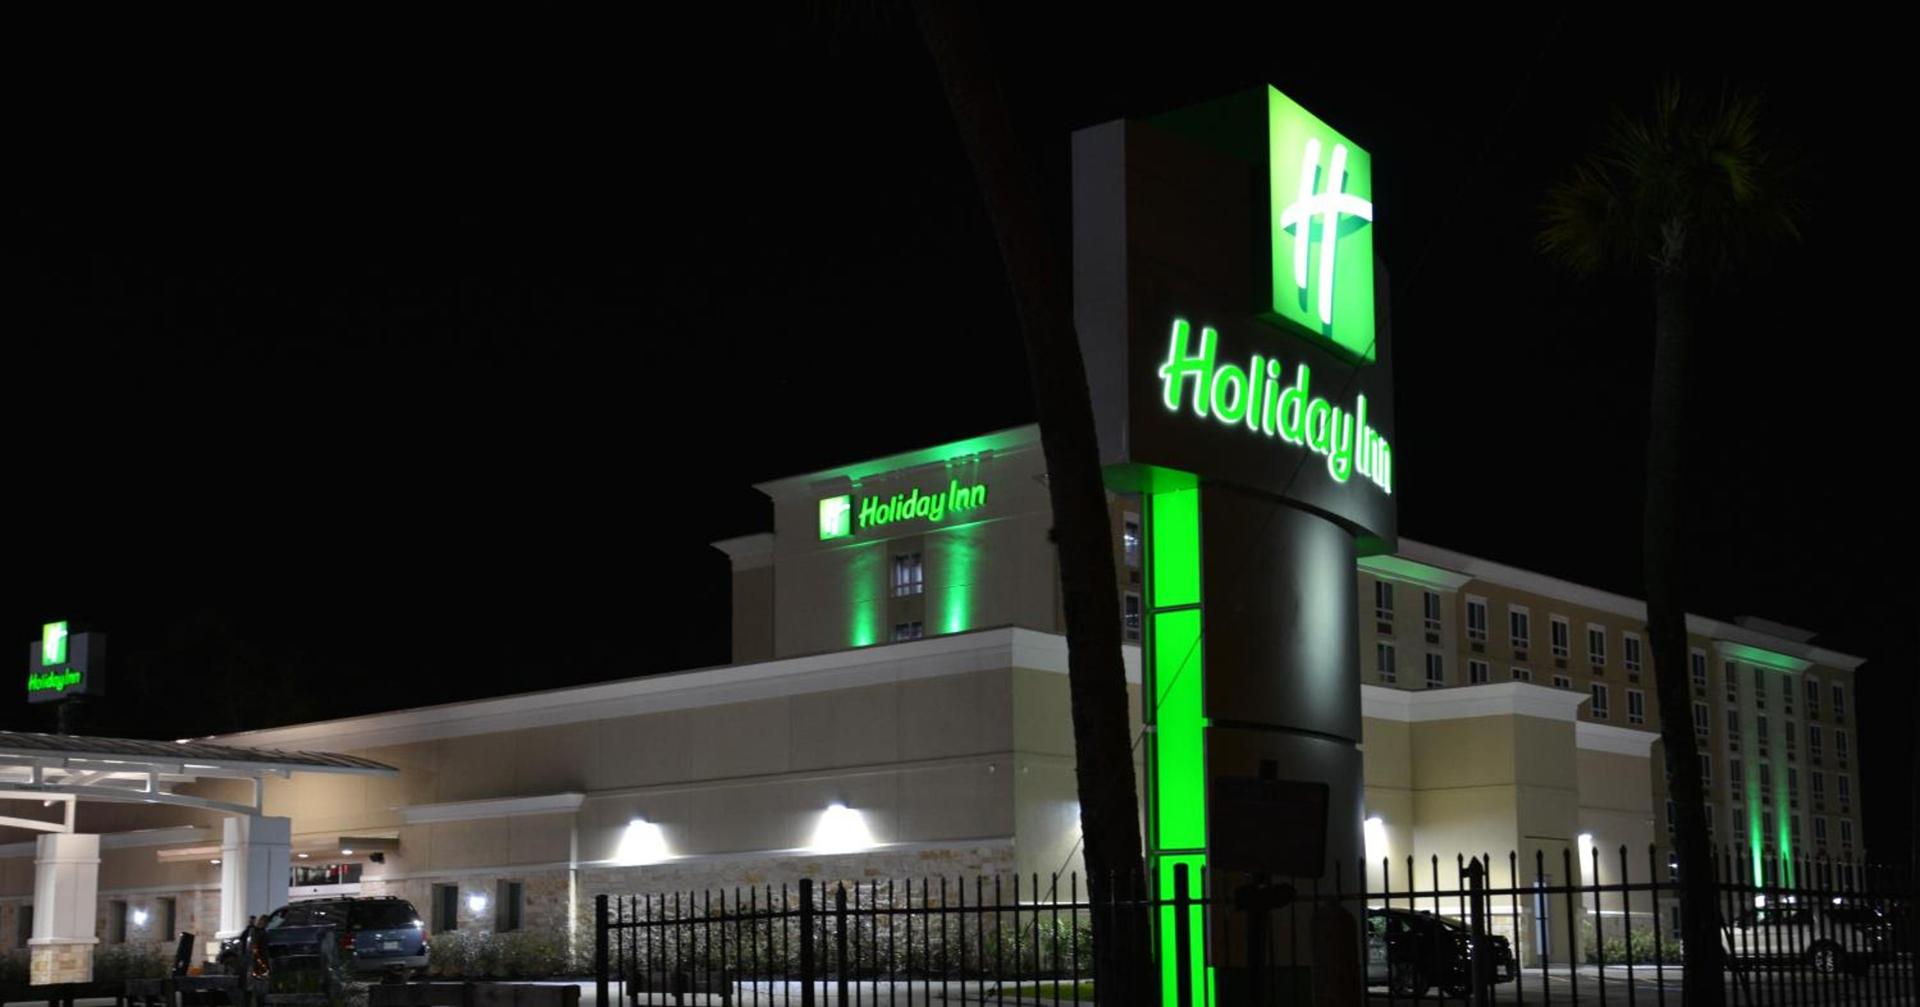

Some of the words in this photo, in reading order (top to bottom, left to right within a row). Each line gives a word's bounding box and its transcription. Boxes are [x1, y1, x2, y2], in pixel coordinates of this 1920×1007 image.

[1158, 318, 1354, 483] Holiday
[1354, 393, 1392, 495] Inn
[858, 488, 946, 527] Holiday
[949, 480, 986, 512] Inn
